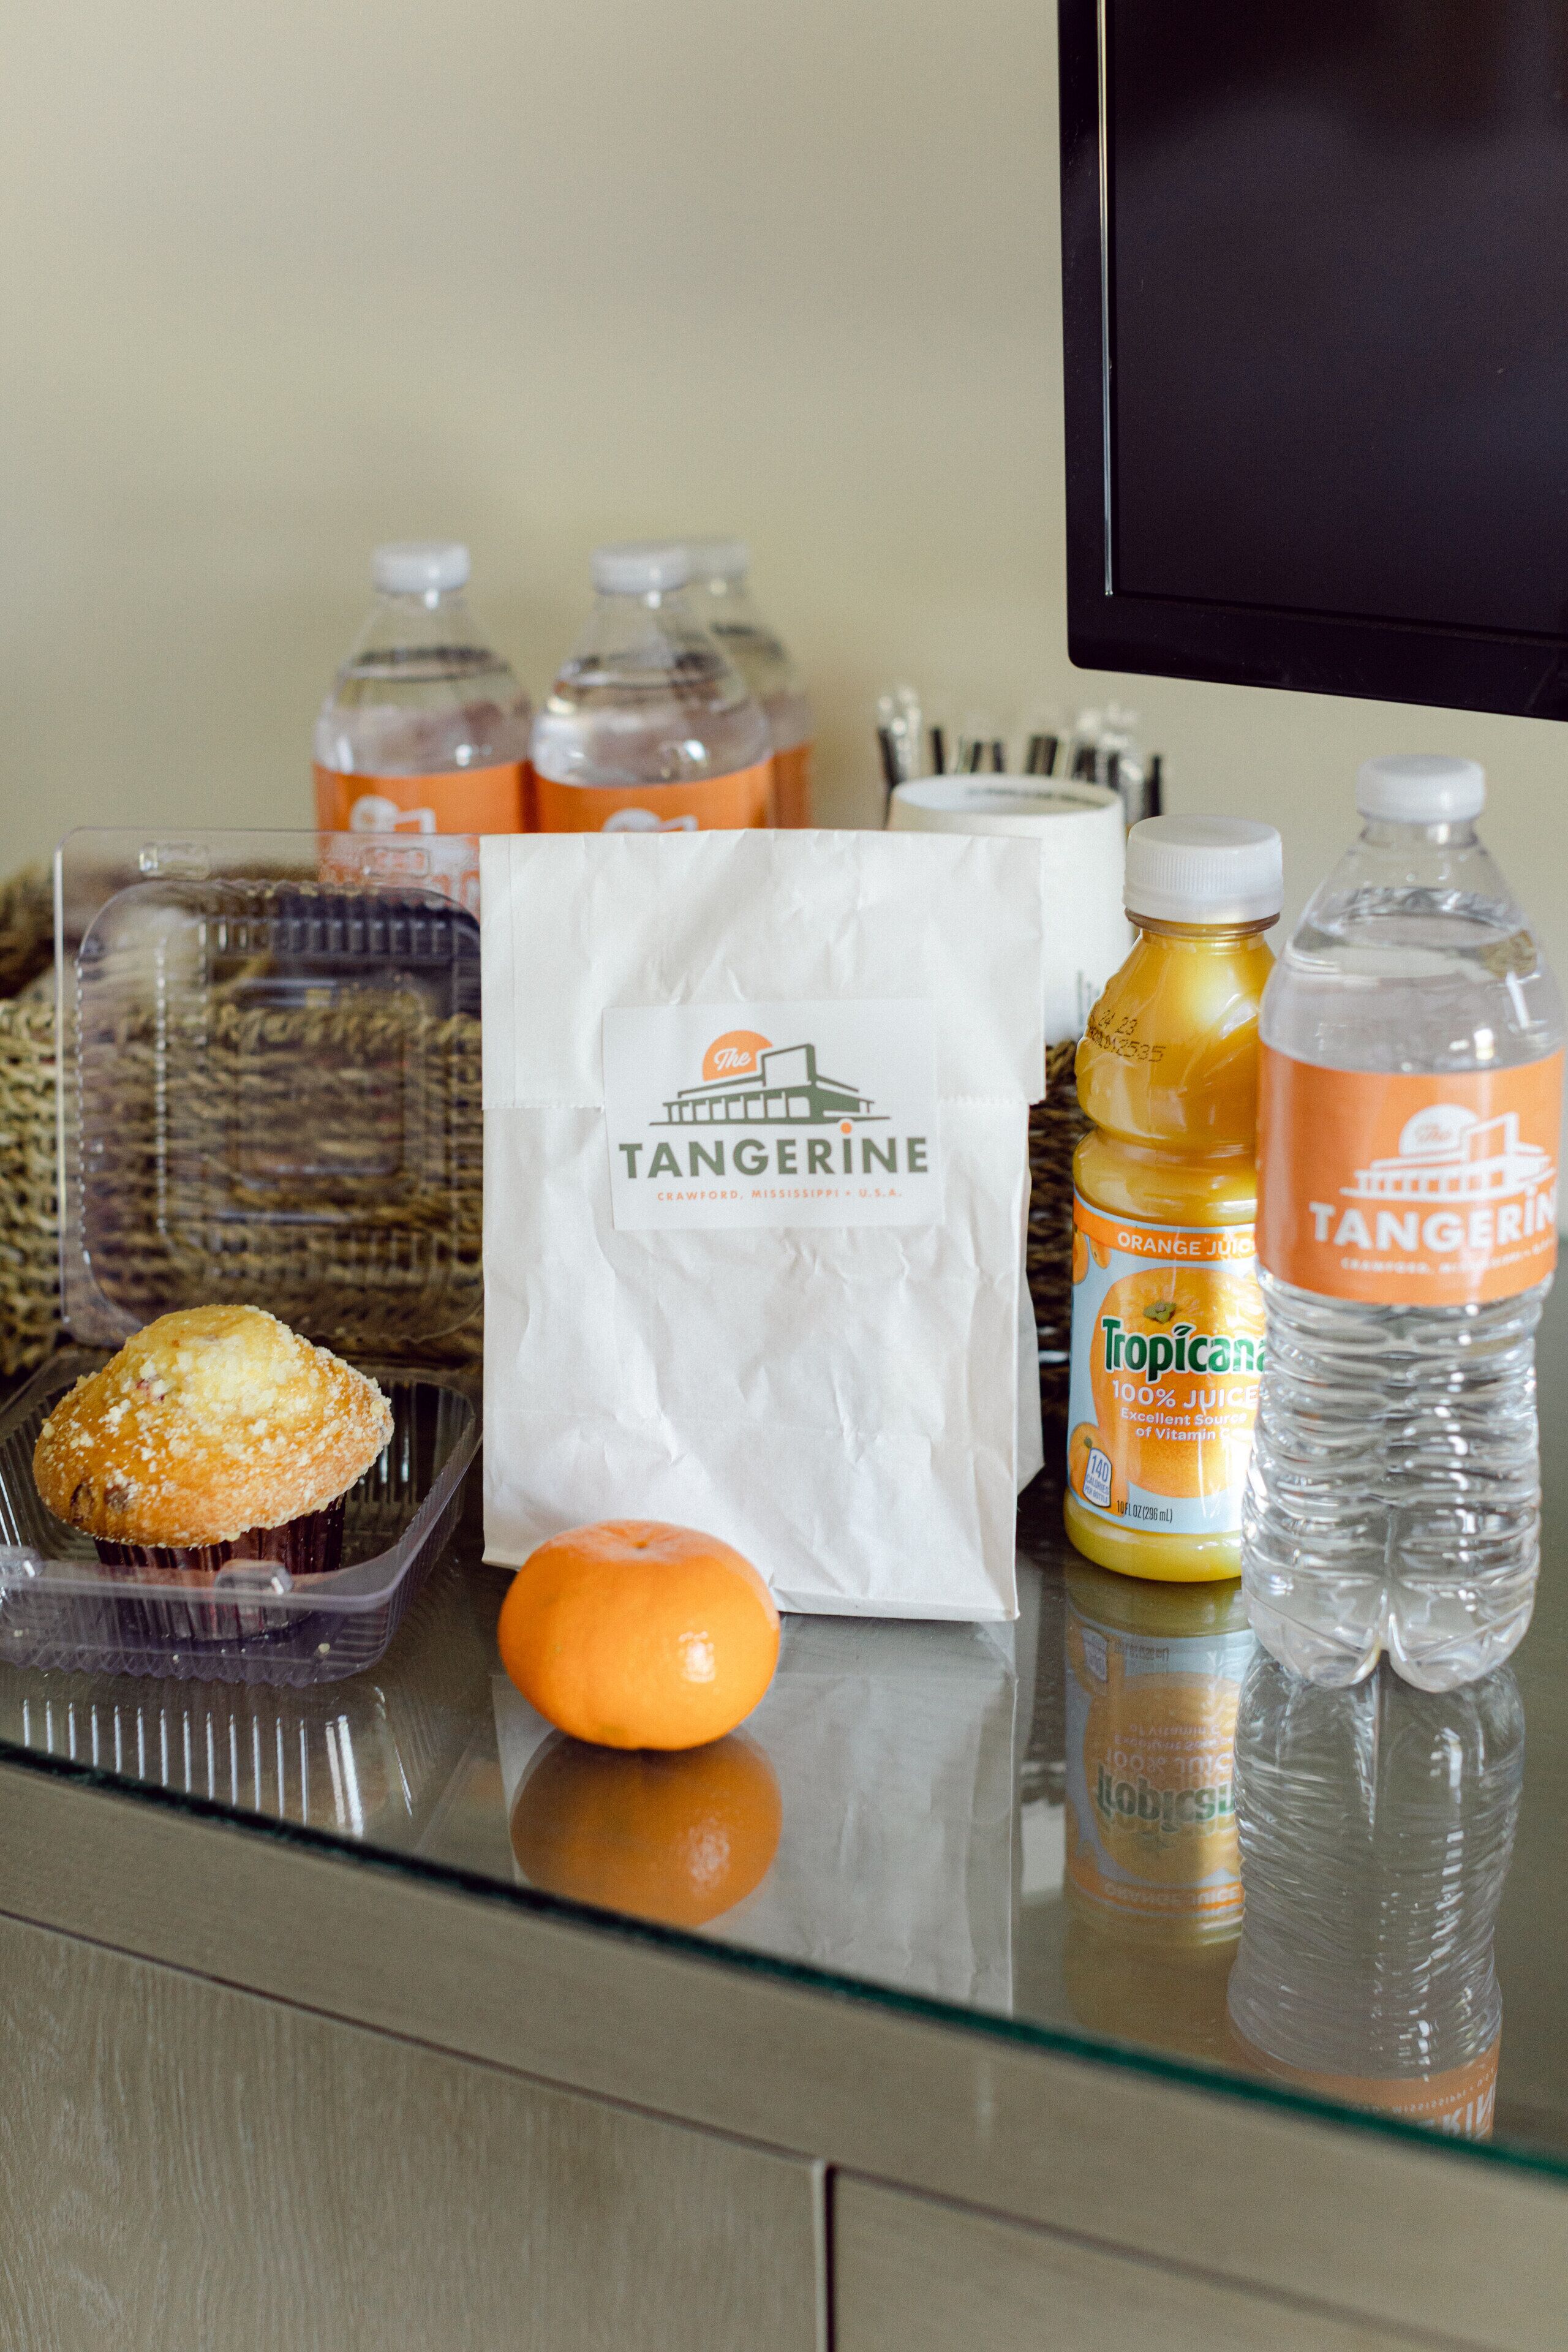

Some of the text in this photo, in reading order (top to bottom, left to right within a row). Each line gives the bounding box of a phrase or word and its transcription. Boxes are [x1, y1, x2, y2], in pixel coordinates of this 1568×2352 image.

[1115, 1016, 1137, 1036] 23
[714, 1047, 752, 1071] The
[619, 1122, 929, 1180] TANGERINE
[657, 1188, 903, 1202] CRAWFORD, MISSISSIPPI U.S.A.
[1117, 1231, 1256, 1256] ORANGE JUIC
[1112, 1379, 1259, 1409] 100% JUICE
[1120, 1407, 1247, 1427] Excellent Source
[1135, 1425, 1152, 1438] of
[1154, 1427, 1216, 1441] Vitamin
[1091, 1455, 1110, 1482] 140
[1085, 1473, 1109, 1495] CALORIES
[1117, 1499, 1124, 1514] 10
[1125, 1502, 1132, 1517] FL
[1159, 1508, 1173, 1523] mL)
